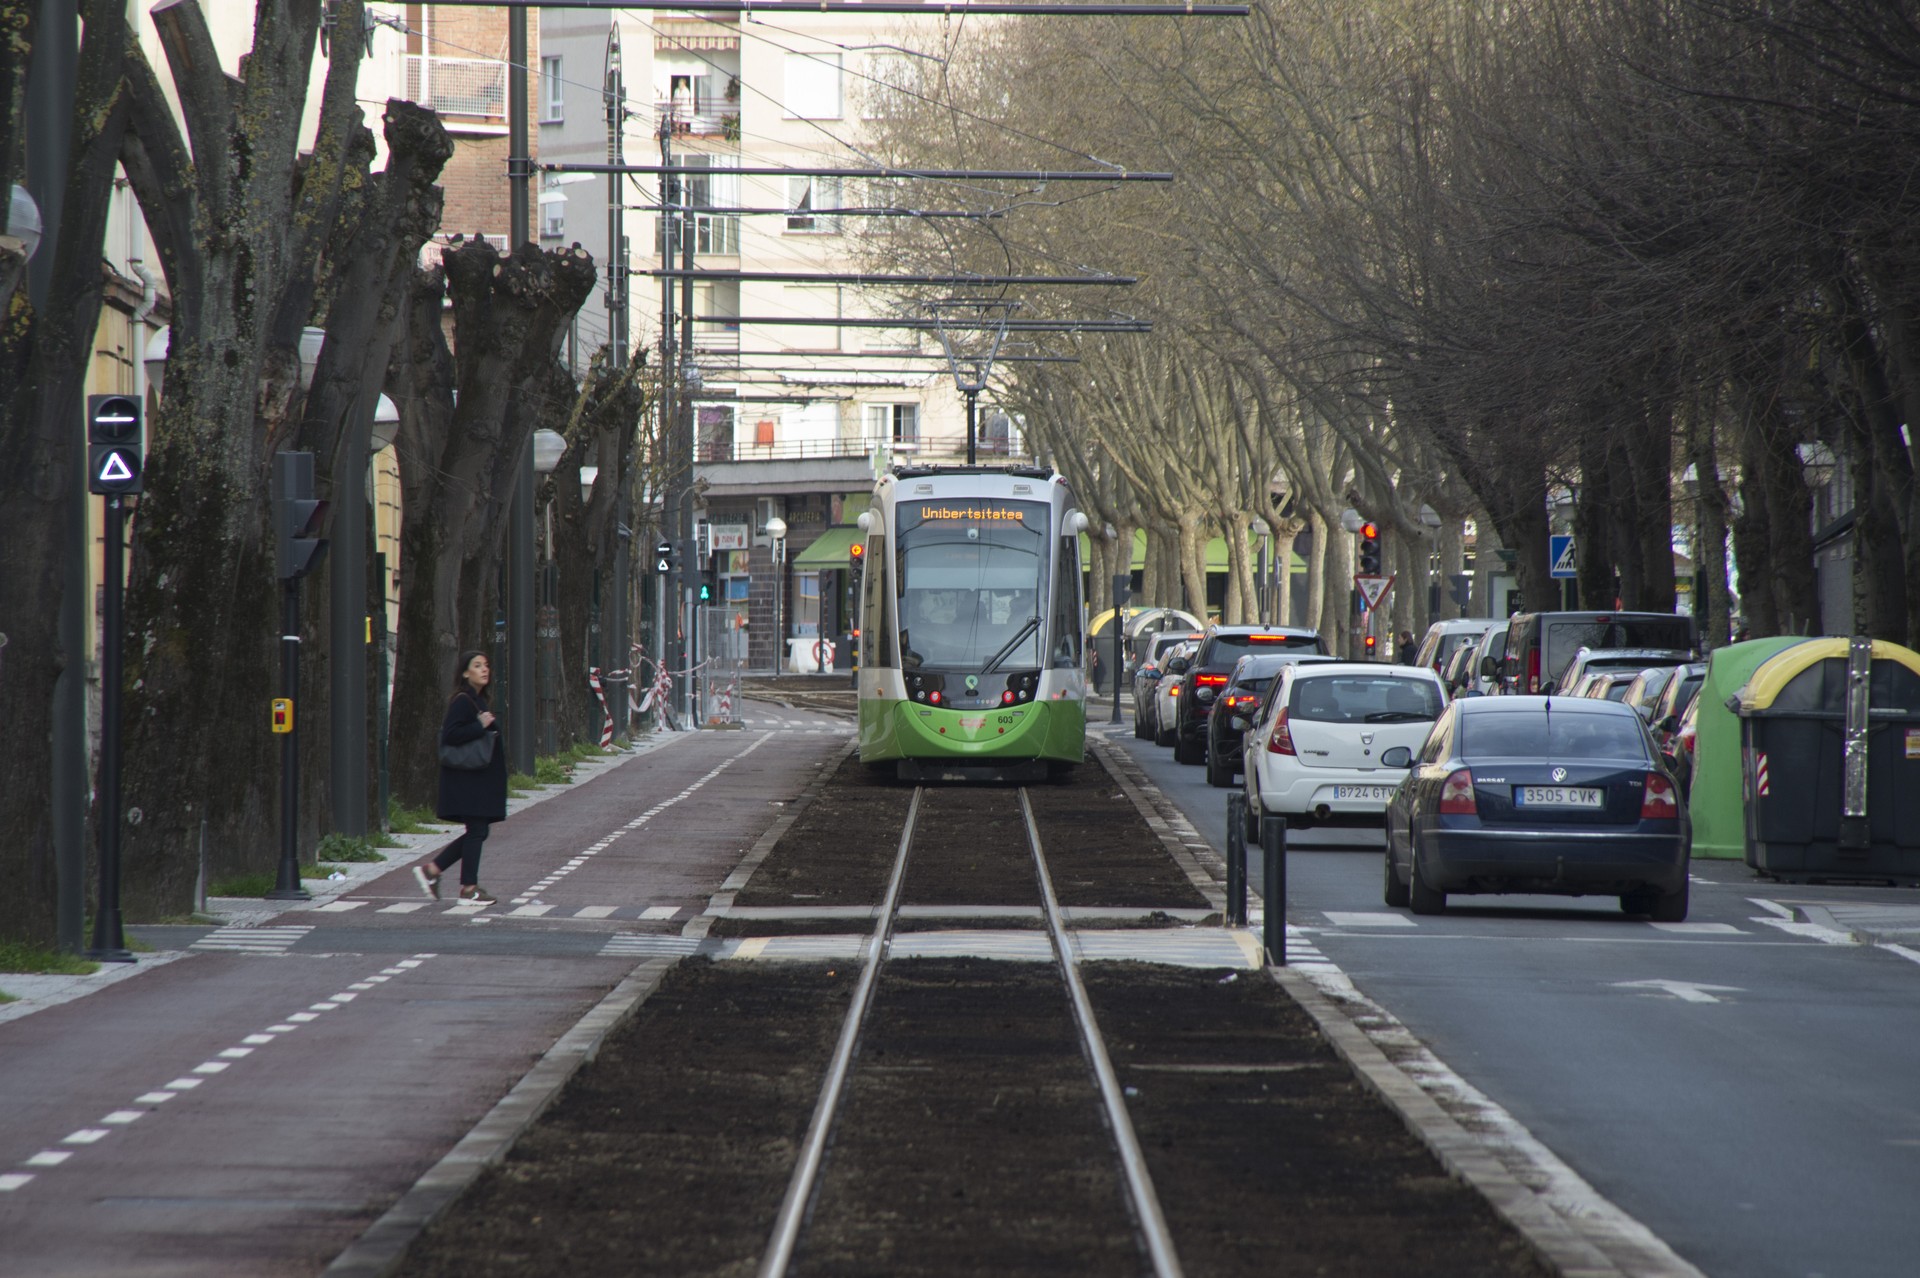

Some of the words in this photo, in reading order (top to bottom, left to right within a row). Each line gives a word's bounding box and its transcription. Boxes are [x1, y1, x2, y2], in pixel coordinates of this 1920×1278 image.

[922, 506, 1023, 520] Unibertsitatea
[997, 715, 1013, 724] 603
[1340, 787, 1369, 798] 8724
[1372, 787, 1394, 798] GTV
[1527, 789, 1563, 803] 3505
[1569, 790, 1596, 803] CVK
